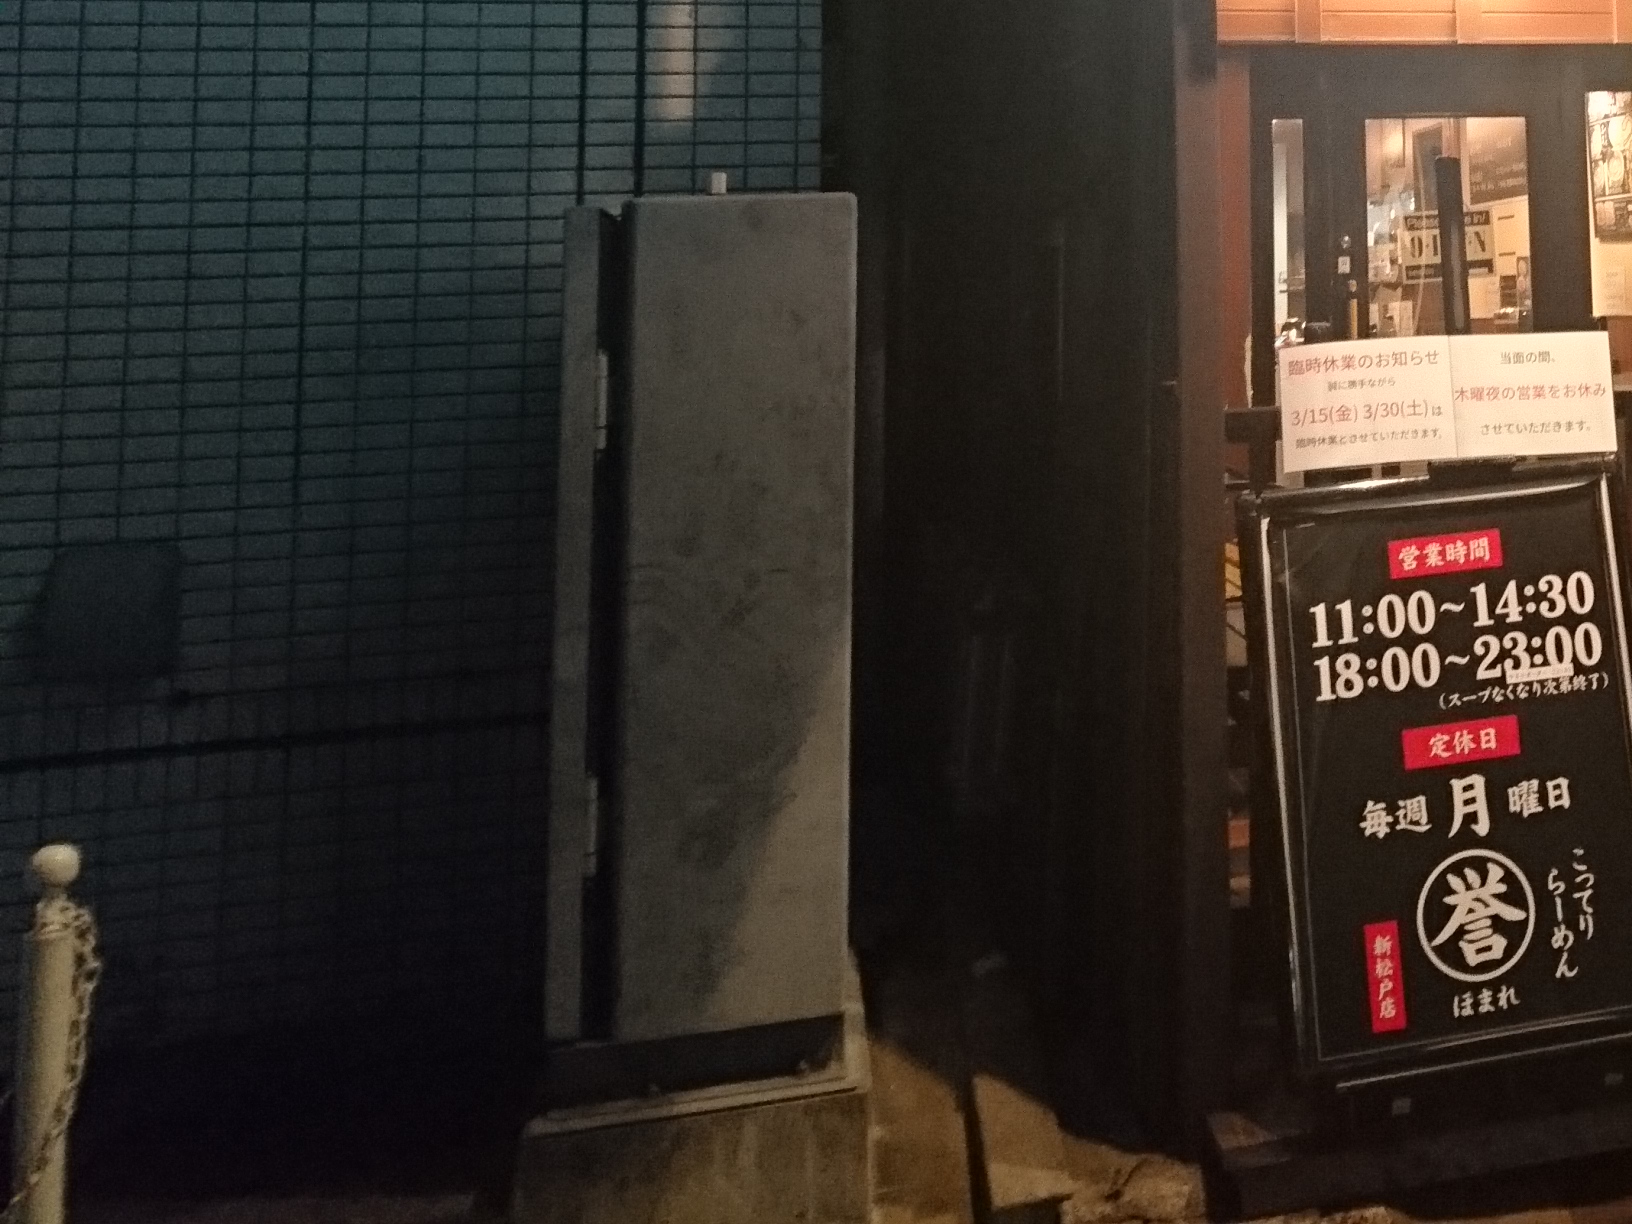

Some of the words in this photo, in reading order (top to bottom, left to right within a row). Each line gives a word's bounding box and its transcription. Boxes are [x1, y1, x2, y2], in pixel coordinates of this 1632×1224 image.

[1287, 349, 1440, 377] 臨時休業のお知らせ
[1454, 383, 1606, 403] 木曜夜の営業をお休み
[1398, 535, 1491, 572] 営業時間
[1428, 727, 1498, 758] 定休日
[1571, 847, 1596, 941] こってり
[1431, 861, 1528, 968] 誉
[1546, 867, 1579, 980] らーめん
[1372, 934, 1398, 1020] 新松戸店
[1452, 984, 1522, 1020] ほまれ
